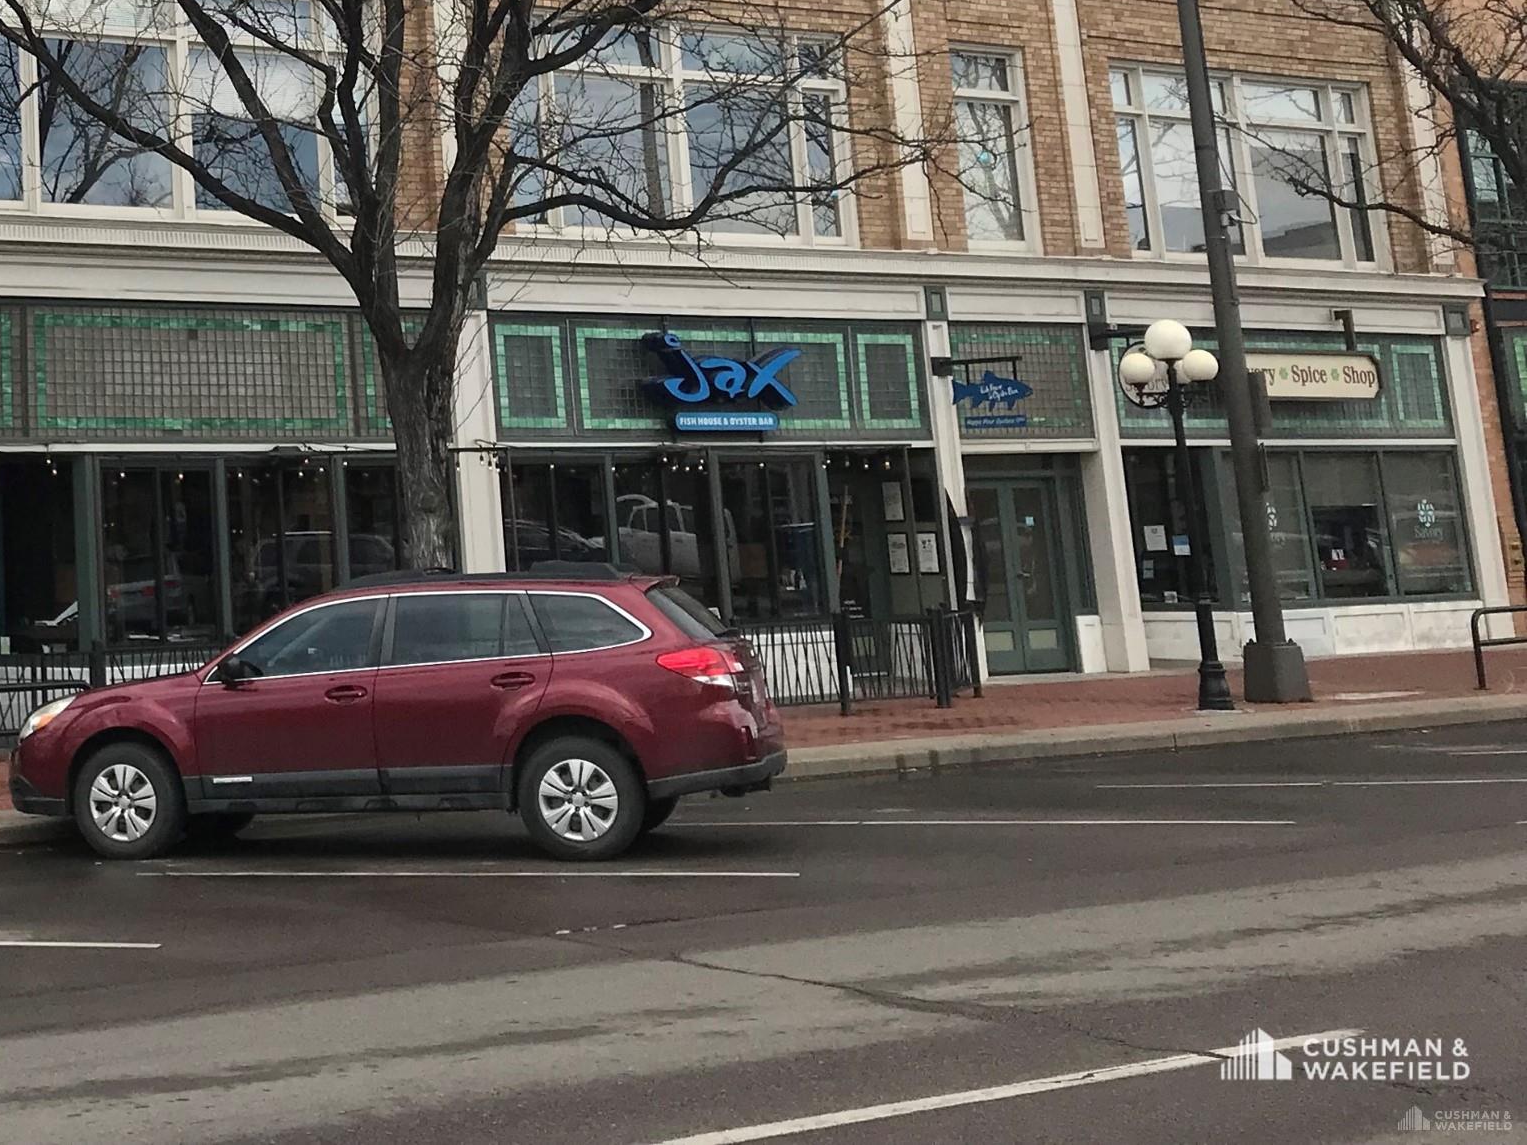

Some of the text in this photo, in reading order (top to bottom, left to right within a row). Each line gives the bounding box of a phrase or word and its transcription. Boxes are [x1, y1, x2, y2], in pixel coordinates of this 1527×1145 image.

[1291, 364, 1328, 387] Spice
[1342, 365, 1376, 388] Shop
[679, 417, 697, 426] FISH
[697, 417, 722, 426] HOUSE
[729, 417, 757, 426] OYSTER
[758, 417, 773, 426] BAR
